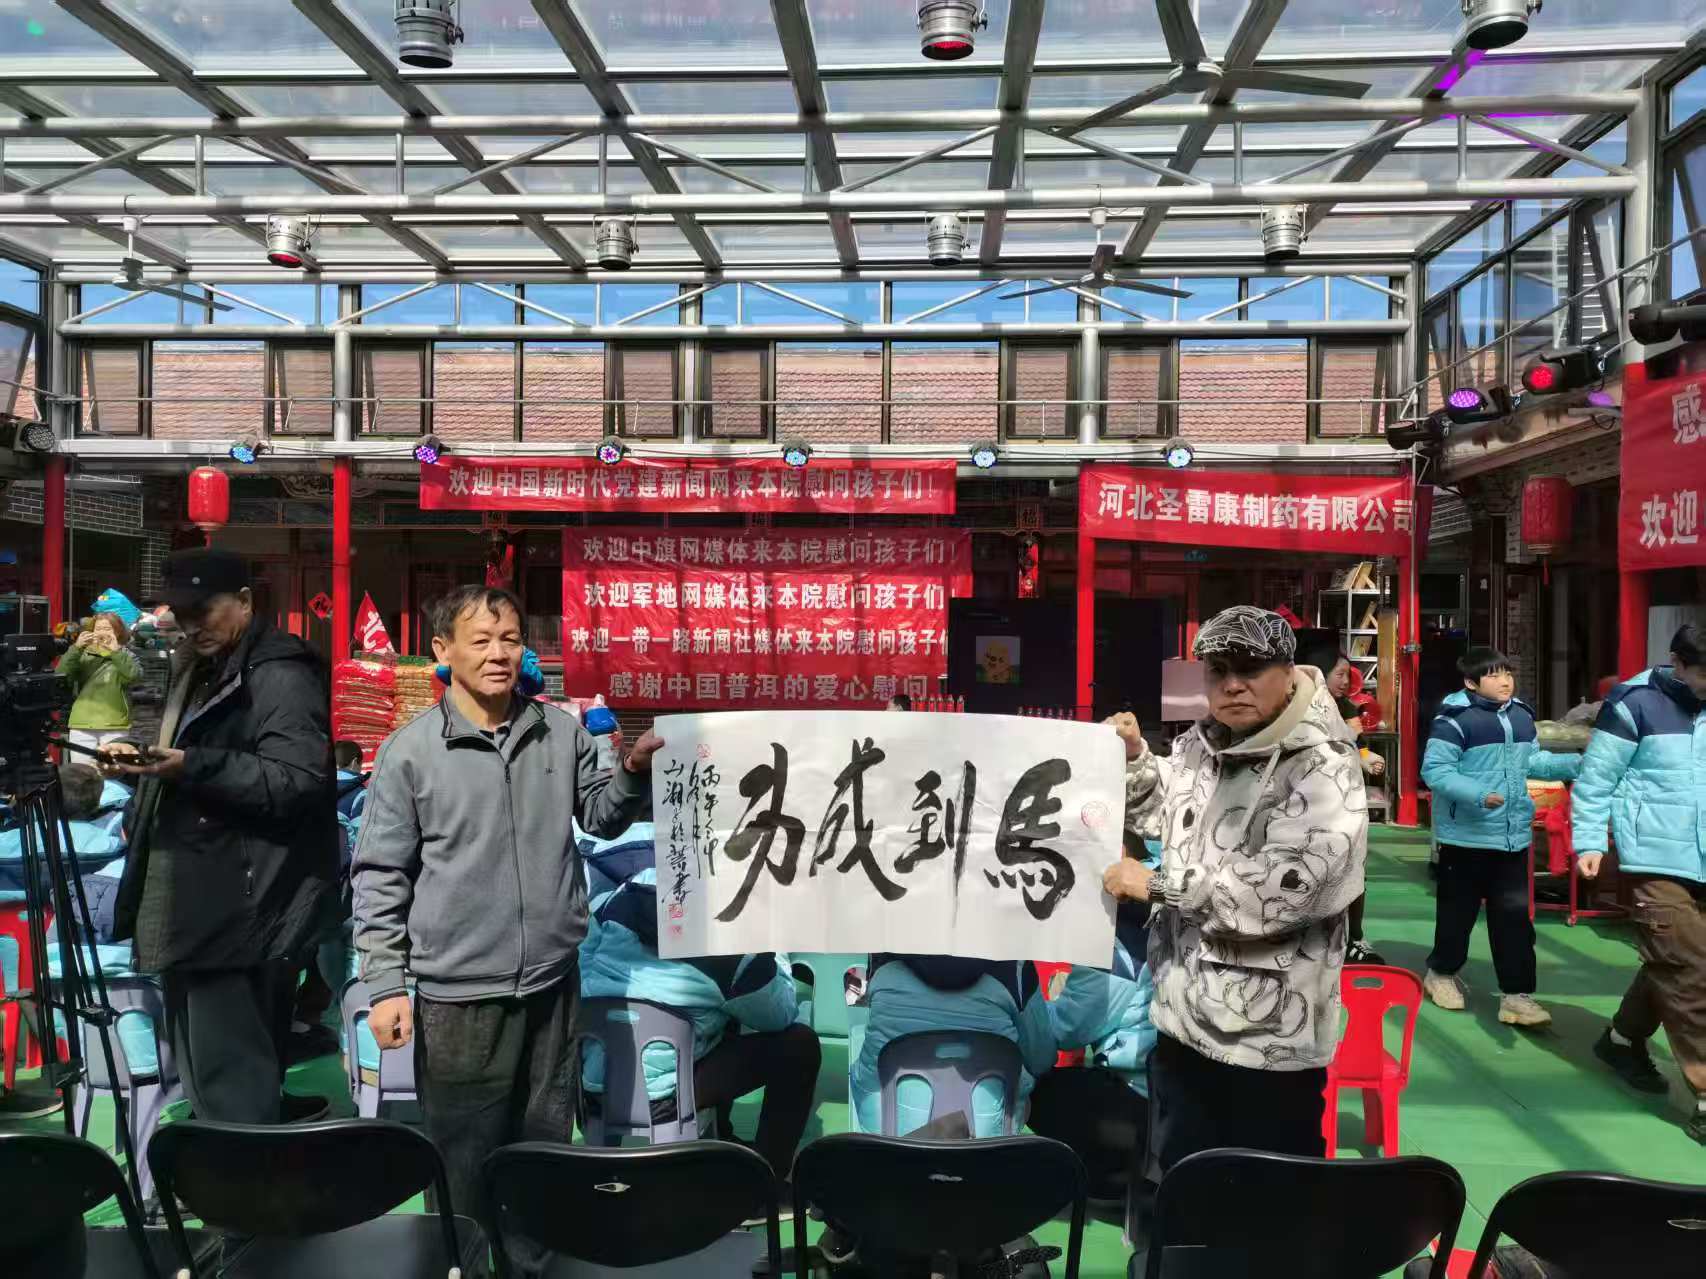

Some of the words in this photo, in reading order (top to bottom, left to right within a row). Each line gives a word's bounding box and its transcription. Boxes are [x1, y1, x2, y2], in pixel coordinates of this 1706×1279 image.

[1099, 481, 1415, 536] 河北圣雷康制药有限公司
[1640, 490, 1699, 548] 欢迎
[609, 671, 928, 699] 感谢中国普洱的爱心慰问
